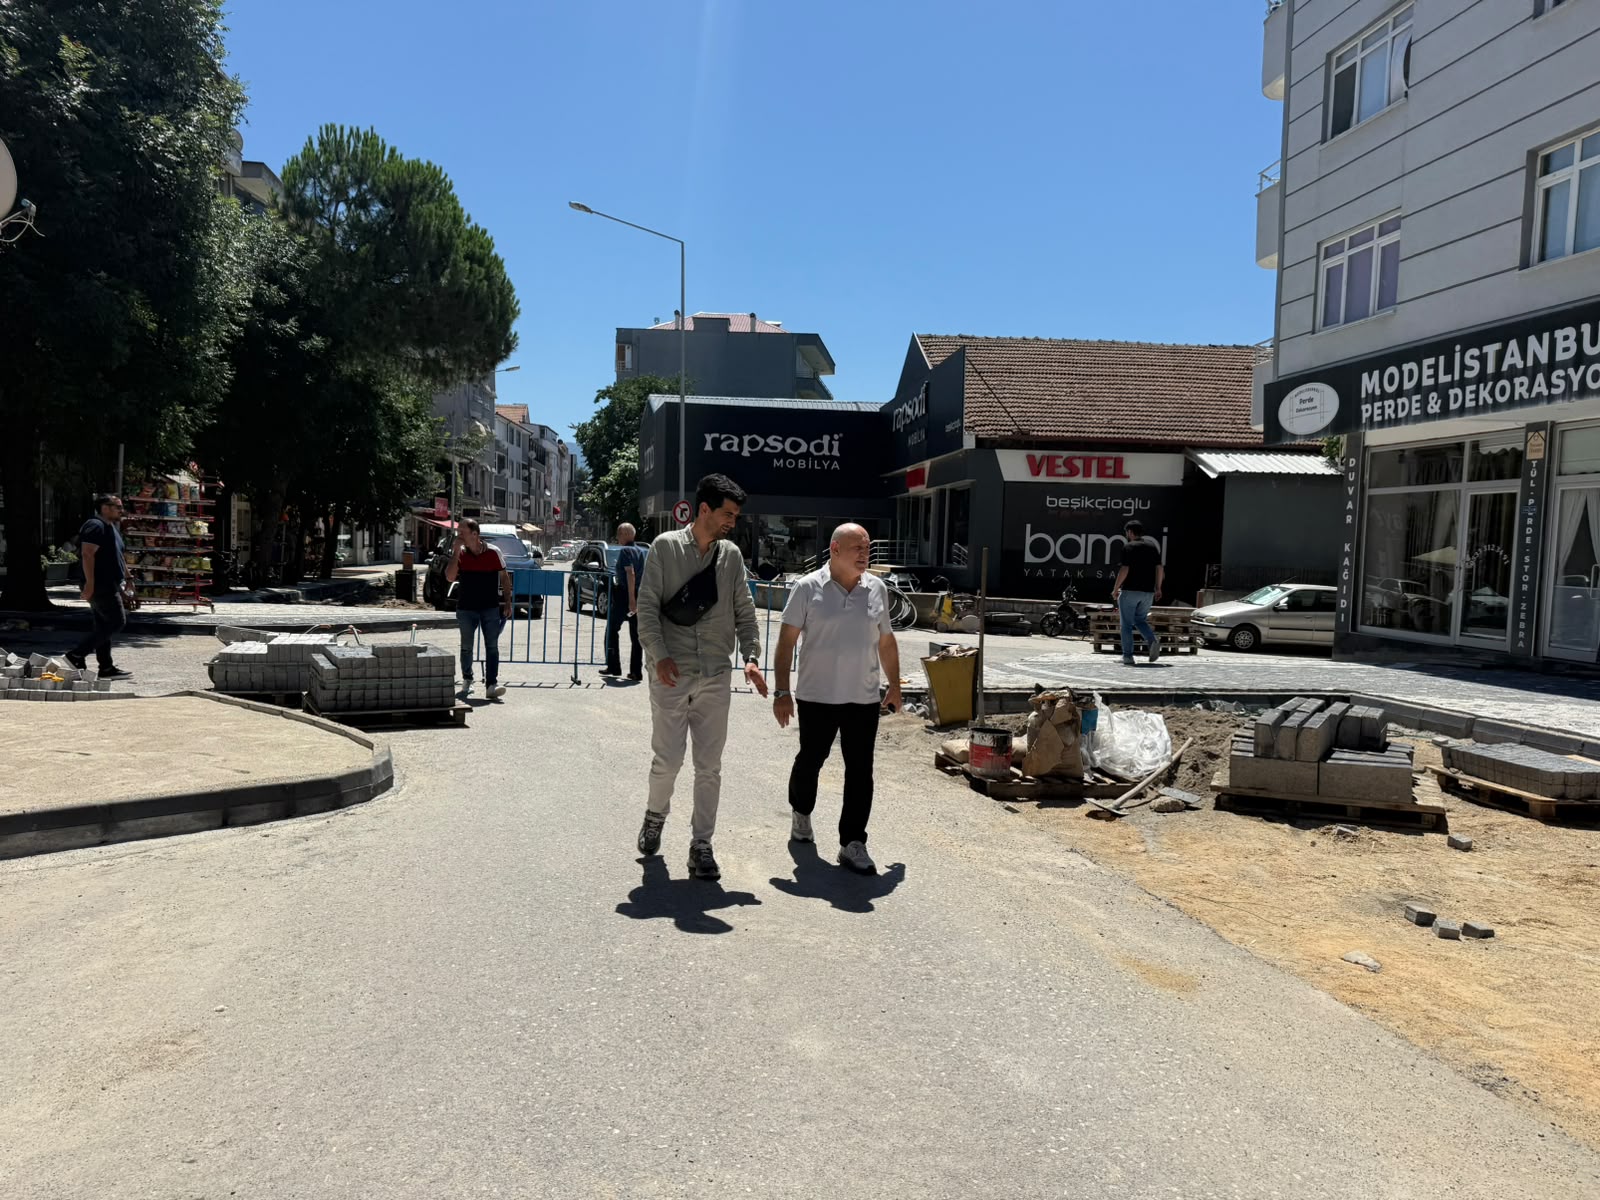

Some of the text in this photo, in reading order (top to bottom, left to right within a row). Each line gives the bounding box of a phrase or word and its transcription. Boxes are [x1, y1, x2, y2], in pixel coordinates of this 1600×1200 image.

[892, 380, 928, 433] rapsodi
[1361, 394, 1421, 423] PERDE
[1427, 392, 1441, 414] &
[704, 433, 841, 457] rapsodi
[773, 457, 841, 470] MOBİLYA
[1026, 454, 1130, 479] VESTEL
[1046, 495, 1151, 516] beşikçioğlu
[1340, 458, 1356, 622] DUVAR KAĞIDI
[1024, 569, 1084, 578] YATAK
